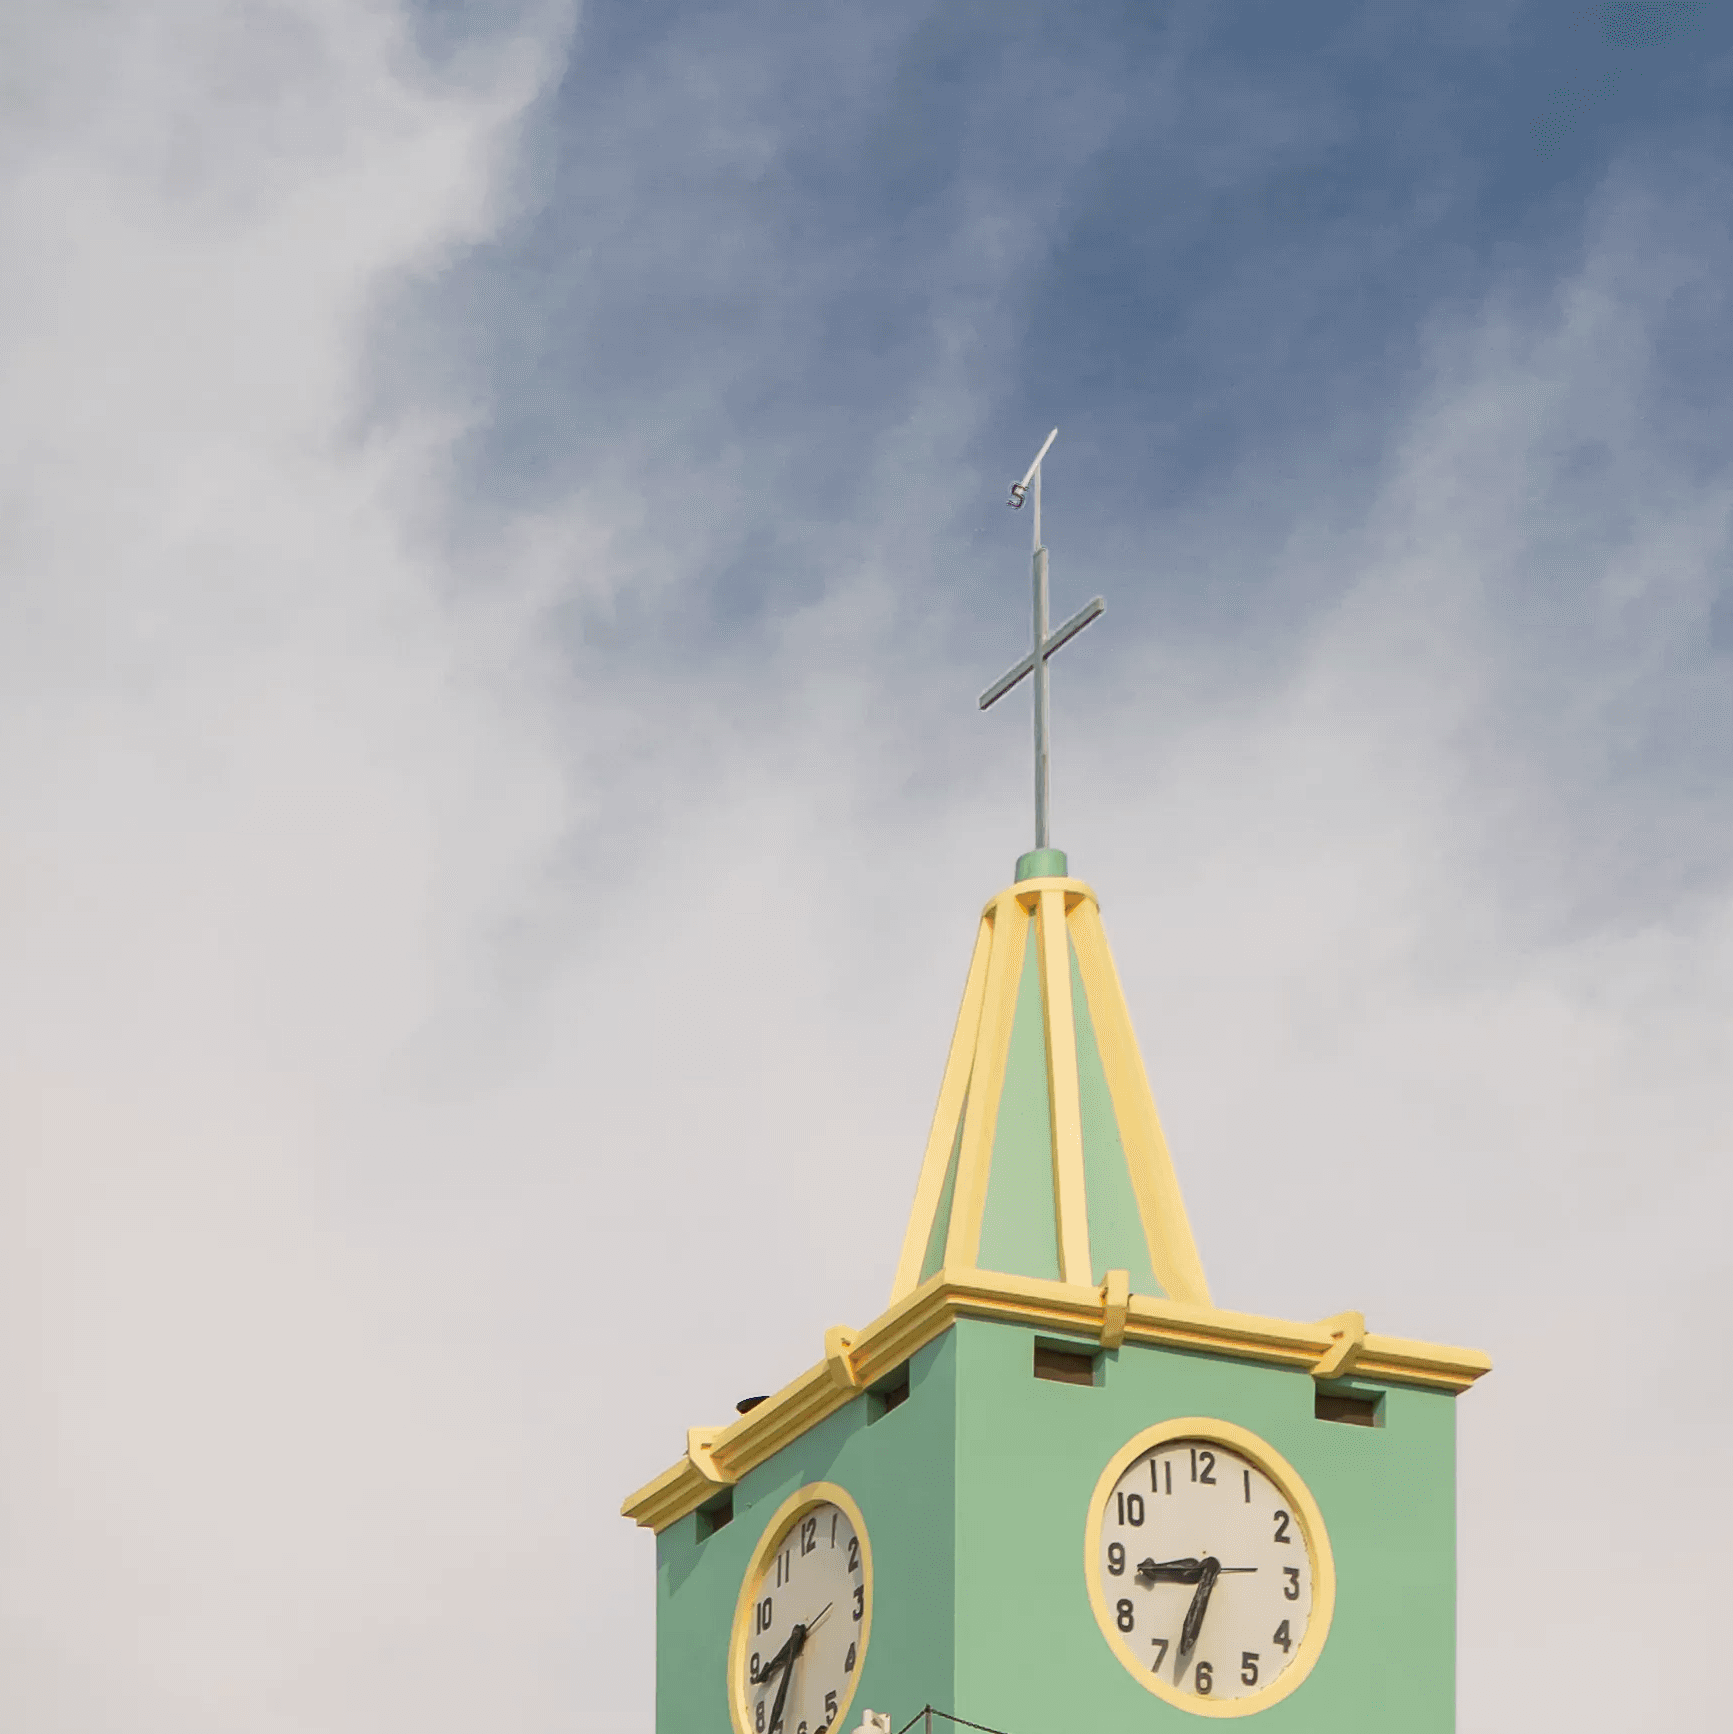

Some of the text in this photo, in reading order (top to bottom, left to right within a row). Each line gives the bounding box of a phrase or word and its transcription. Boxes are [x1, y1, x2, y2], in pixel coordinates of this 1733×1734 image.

[1151, 1460, 1172, 1495] 11
[1191, 1449, 1216, 1485] 12
[1244, 1470, 1251, 1503] 1
[1118, 1492, 1144, 1527] 10
[801, 1518, 816, 1557] 12
[831, 1514, 837, 1549] 1
[1274, 1510, 1291, 1544] 2
[777, 1550, 790, 1588] 11
[848, 1536, 859, 1574] 2
[1108, 1542, 1125, 1576] 9
[1283, 1567, 1300, 1600] 3
[756, 1598, 772, 1635] 10
[853, 1584, 864, 1621] 3
[1117, 1599, 1134, 1633] 8
[1274, 1620, 1291, 1653] 4
[845, 1642, 856, 1673] 4
[1151, 1639, 1169, 1673] 7
[1241, 1652, 1259, 1686] 5
[1196, 1661, 1213, 1694] 6
[755, 1701, 765, 1734] 8
[825, 1691, 837, 1724] 5
